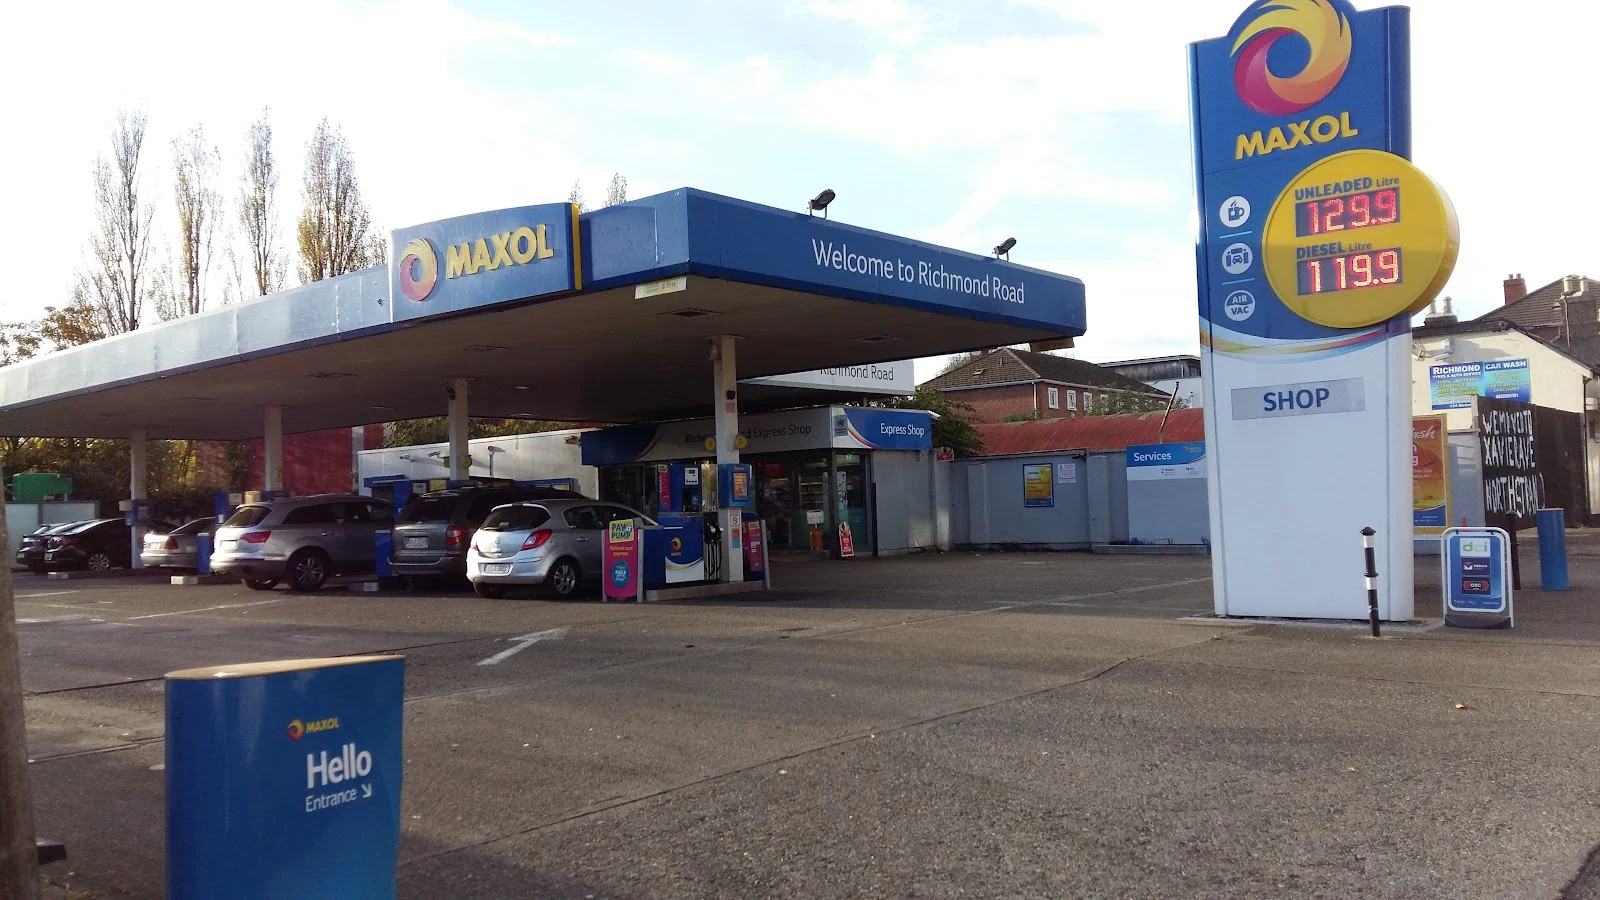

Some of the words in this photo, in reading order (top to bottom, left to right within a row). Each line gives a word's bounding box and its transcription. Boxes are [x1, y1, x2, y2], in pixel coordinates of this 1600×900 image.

[1234, 111, 1359, 160] MAXOL
[1294, 176, 1373, 201] UNLEADED
[1375, 175, 1400, 188] Litre
[1307, 188, 1397, 234] 129.9
[446, 223, 554, 280] MAXOL
[1296, 242, 1346, 260] DIESEL
[1349, 241, 1372, 253] Litre
[811, 238, 894, 279] Welcome
[897, 259, 915, 283] to
[918, 261, 990, 298] Richmond
[993, 276, 1025, 304] Road
[1309, 249, 1399, 294] 119.9
[1231, 294, 1249, 305] AIR
[1231, 305, 1250, 316] VAC
[871, 365, 894, 381] Road
[1433, 364, 1481, 375] RICHMOND
[1503, 360, 1526, 369] WASH
[1263, 388, 1330, 411] SHOP
[685, 432, 706, 444] Rich
[753, 427, 787, 440] Express
[789, 423, 811, 437] Shop
[880, 422, 907, 436] Express
[907, 423, 925, 438] Shop
[1412, 425, 1435, 439] ash
[1133, 451, 1172, 462] Services
[611, 523, 626, 532] PAY
[611, 531, 631, 540] PUMP
[306, 717, 339, 734] MAXOL
[306, 743, 372, 789] Hello
[305, 787, 357, 813] Entrance
